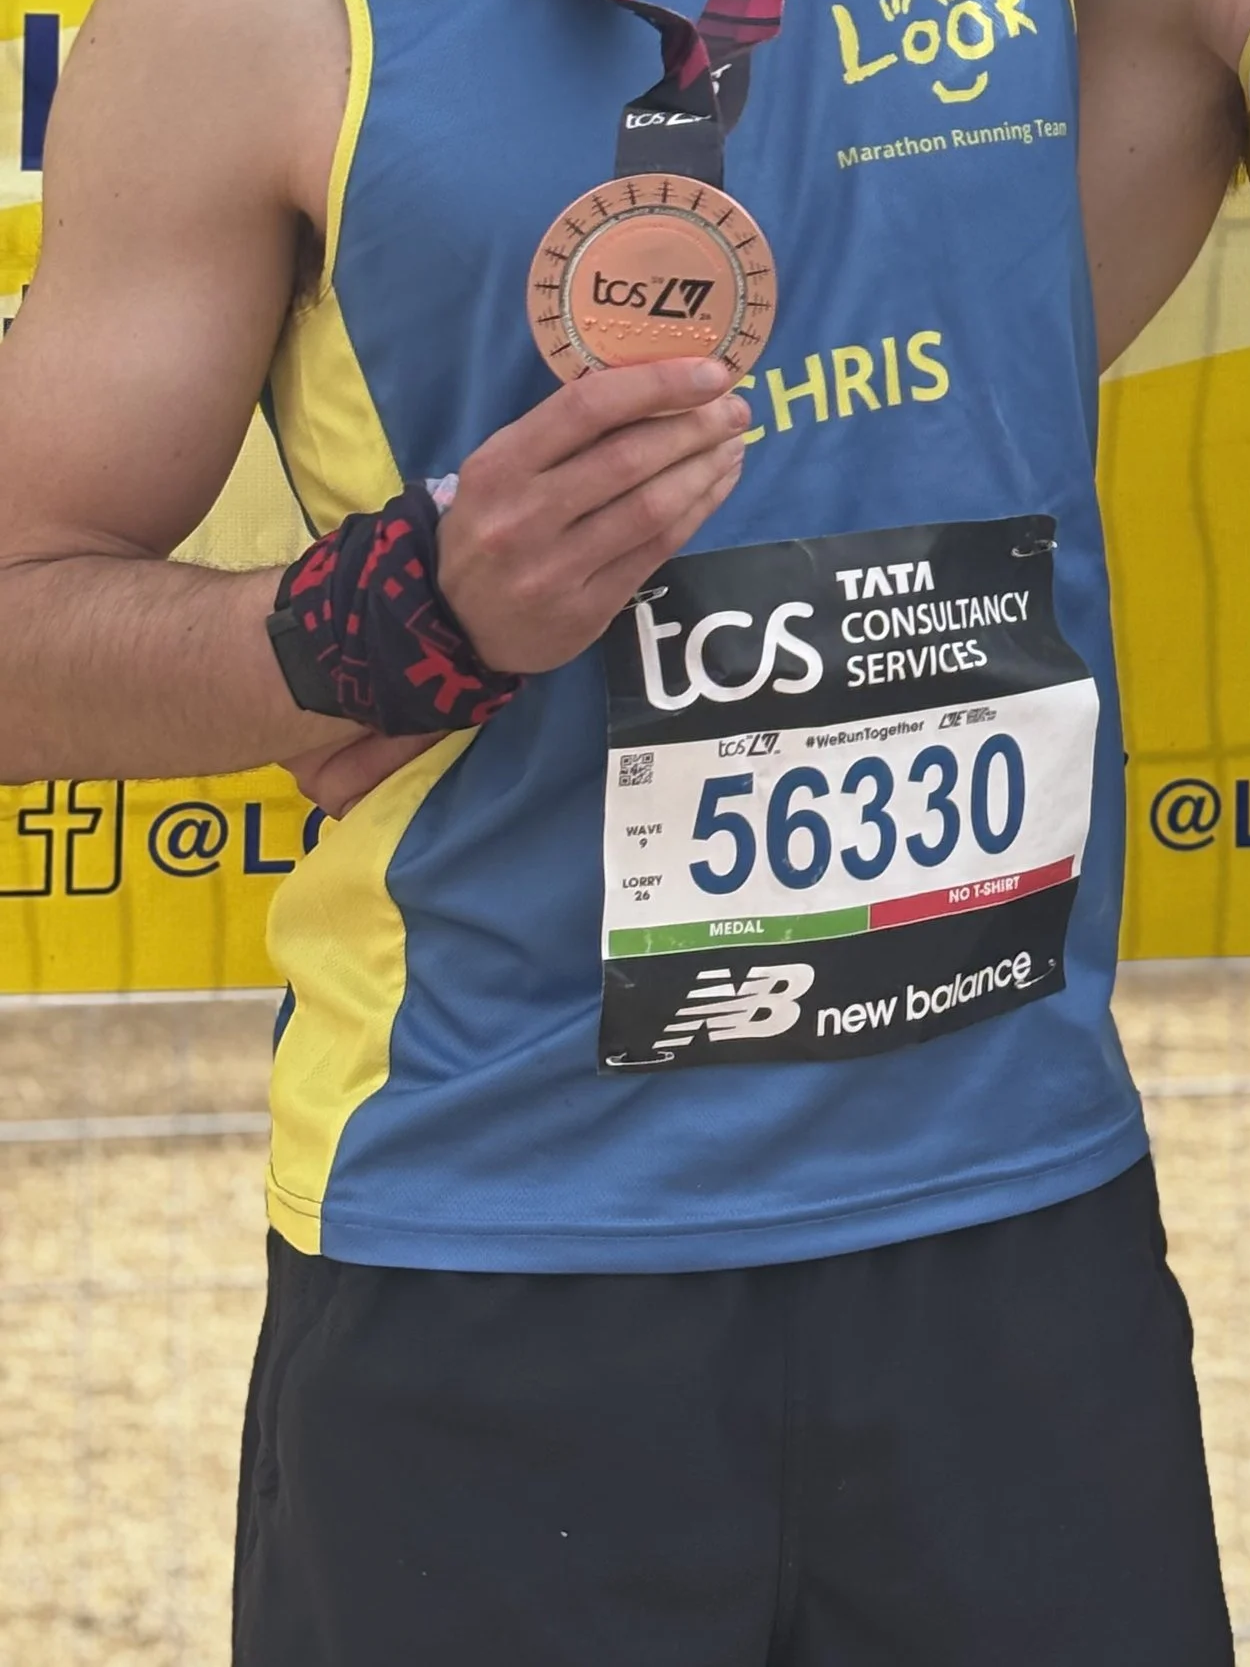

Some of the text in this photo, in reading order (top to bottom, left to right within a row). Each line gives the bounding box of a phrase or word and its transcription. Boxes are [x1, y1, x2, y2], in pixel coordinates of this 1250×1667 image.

[837, 117, 1068, 169] Marathon Running Team
[592, 270, 648, 309] tcs
[836, 561, 935, 601] TATA
[840, 590, 1030, 644] CONSULTANCY
[635, 601, 824, 711] tcs
[846, 639, 988, 688] SERVICES
[805, 720, 926, 749] #WeRunTogether
[625, 823, 663, 837] WAVE
[689, 732, 1026, 896] 56330
[148, 801, 322, 877] @L
[638, 837, 649, 850] 9
[622, 875, 664, 889] LORRY
[633, 889, 652, 902] 26
[948, 876, 1020, 904] NO T-SHIRT
[709, 919, 765, 937] MEDAL
[816, 994, 901, 1038] new
[905, 949, 1033, 1022] balance
